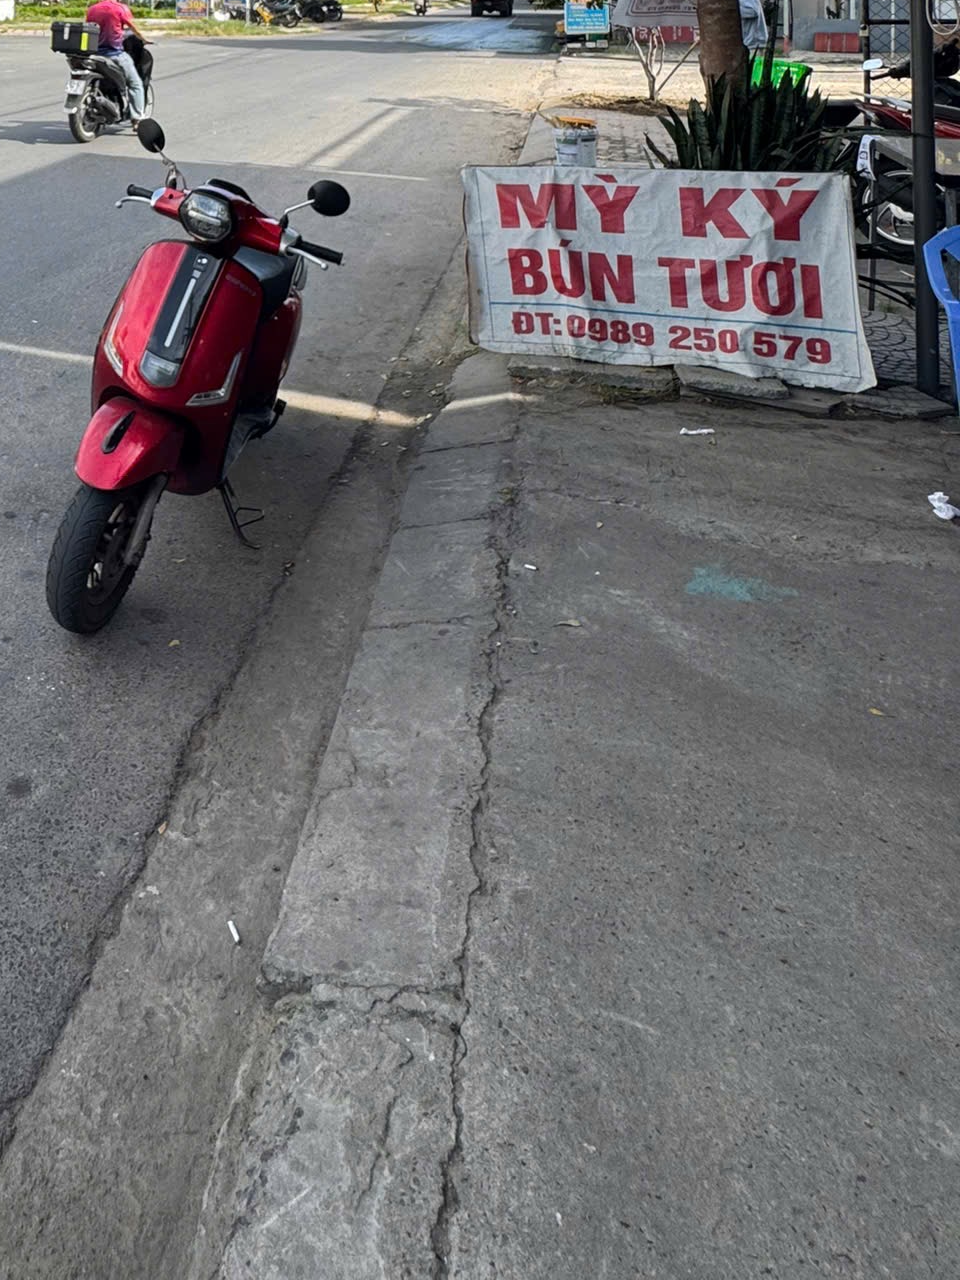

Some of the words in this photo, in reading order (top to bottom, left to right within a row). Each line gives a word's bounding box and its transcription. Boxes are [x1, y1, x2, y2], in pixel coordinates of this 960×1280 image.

[496, 174, 640, 234] MỲ
[678, 178, 819, 241] KÝ
[507, 239, 636, 304] BÚN
[657, 254, 824, 319] TƯƠI
[668, 325, 740, 353] 250
[753, 331, 832, 364] 579
